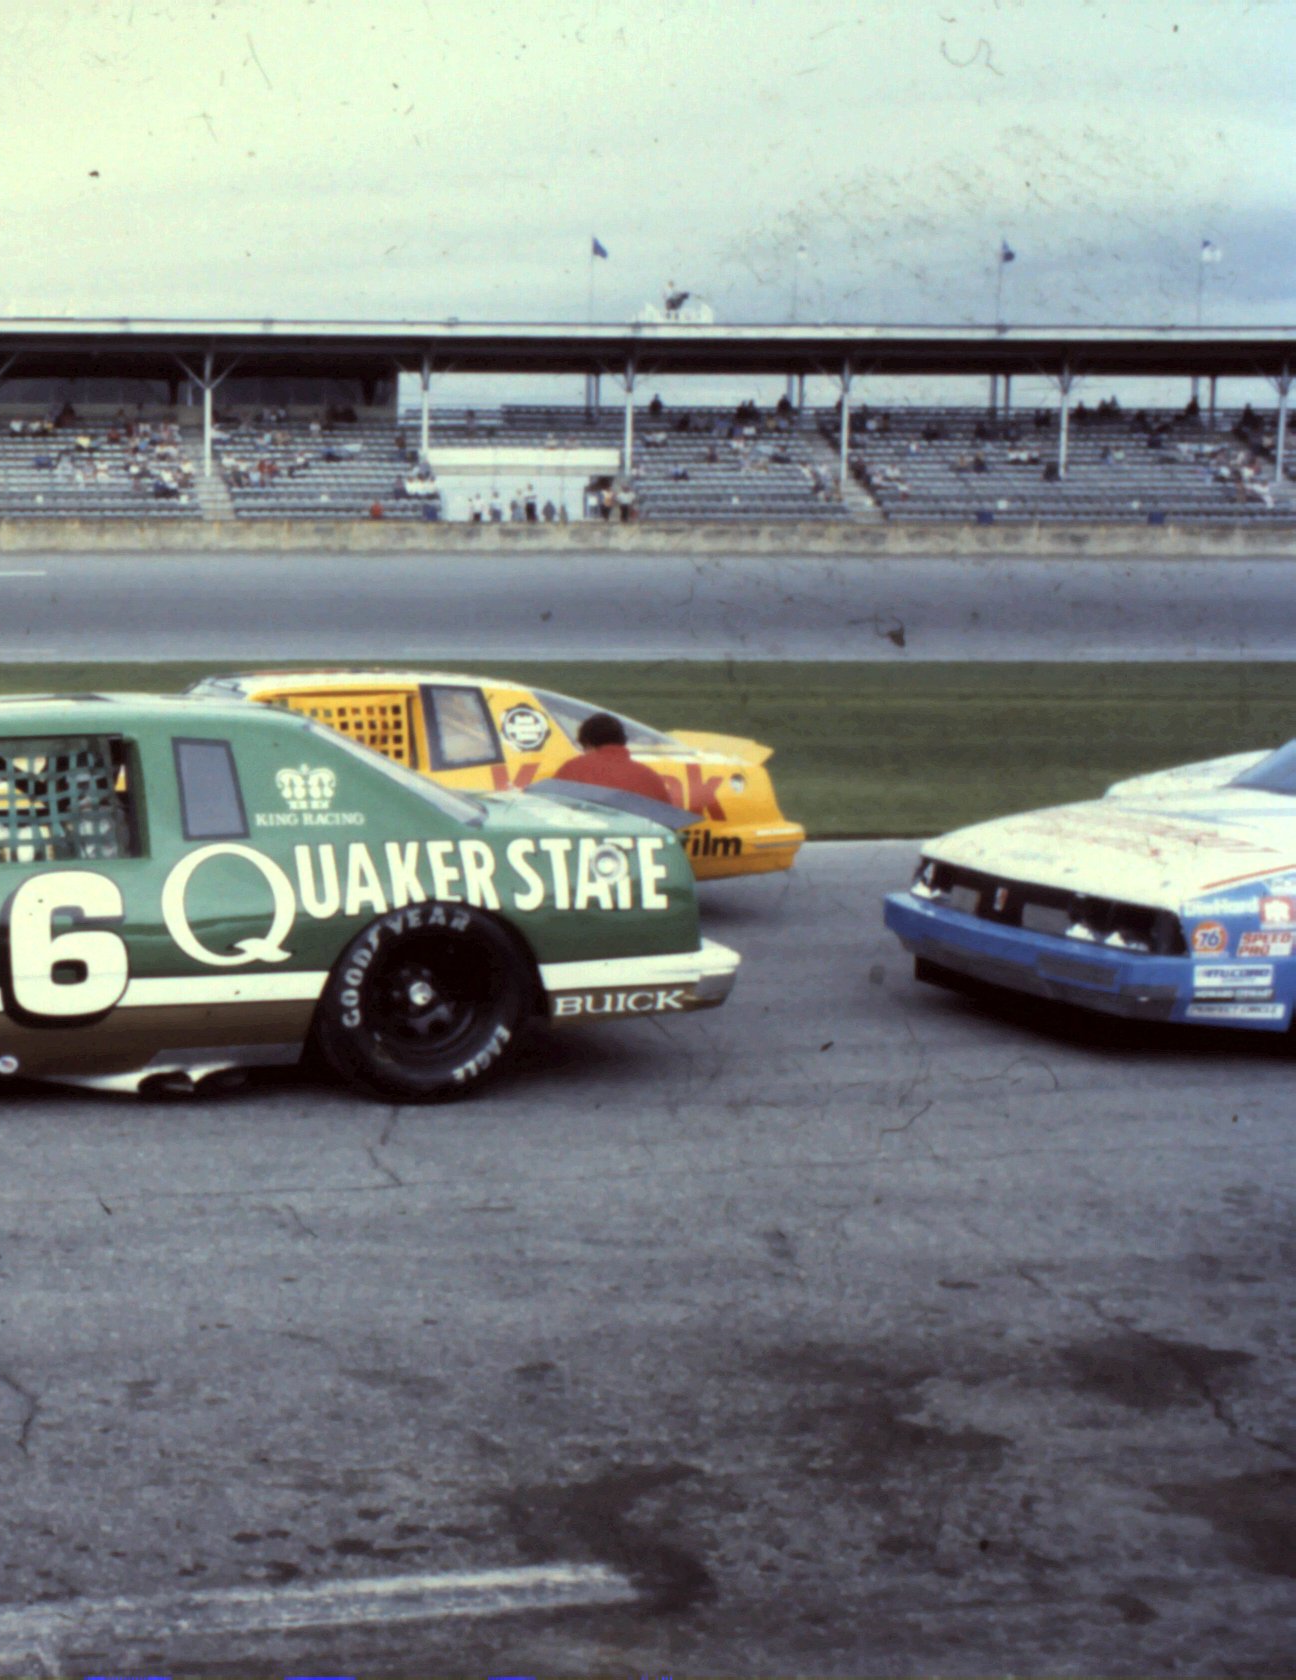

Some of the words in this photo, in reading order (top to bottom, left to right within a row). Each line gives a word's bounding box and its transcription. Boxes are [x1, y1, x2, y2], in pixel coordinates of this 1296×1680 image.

[255, 812, 300, 826] KING
[302, 811, 366, 826] RACING
[161, 838, 501, 966] QUAKER
[507, 836, 669, 912] STATE
[1197, 931, 1221, 948] 76
[553, 988, 687, 1017] BUICK
[452, 1024, 511, 1082] EAGLE
